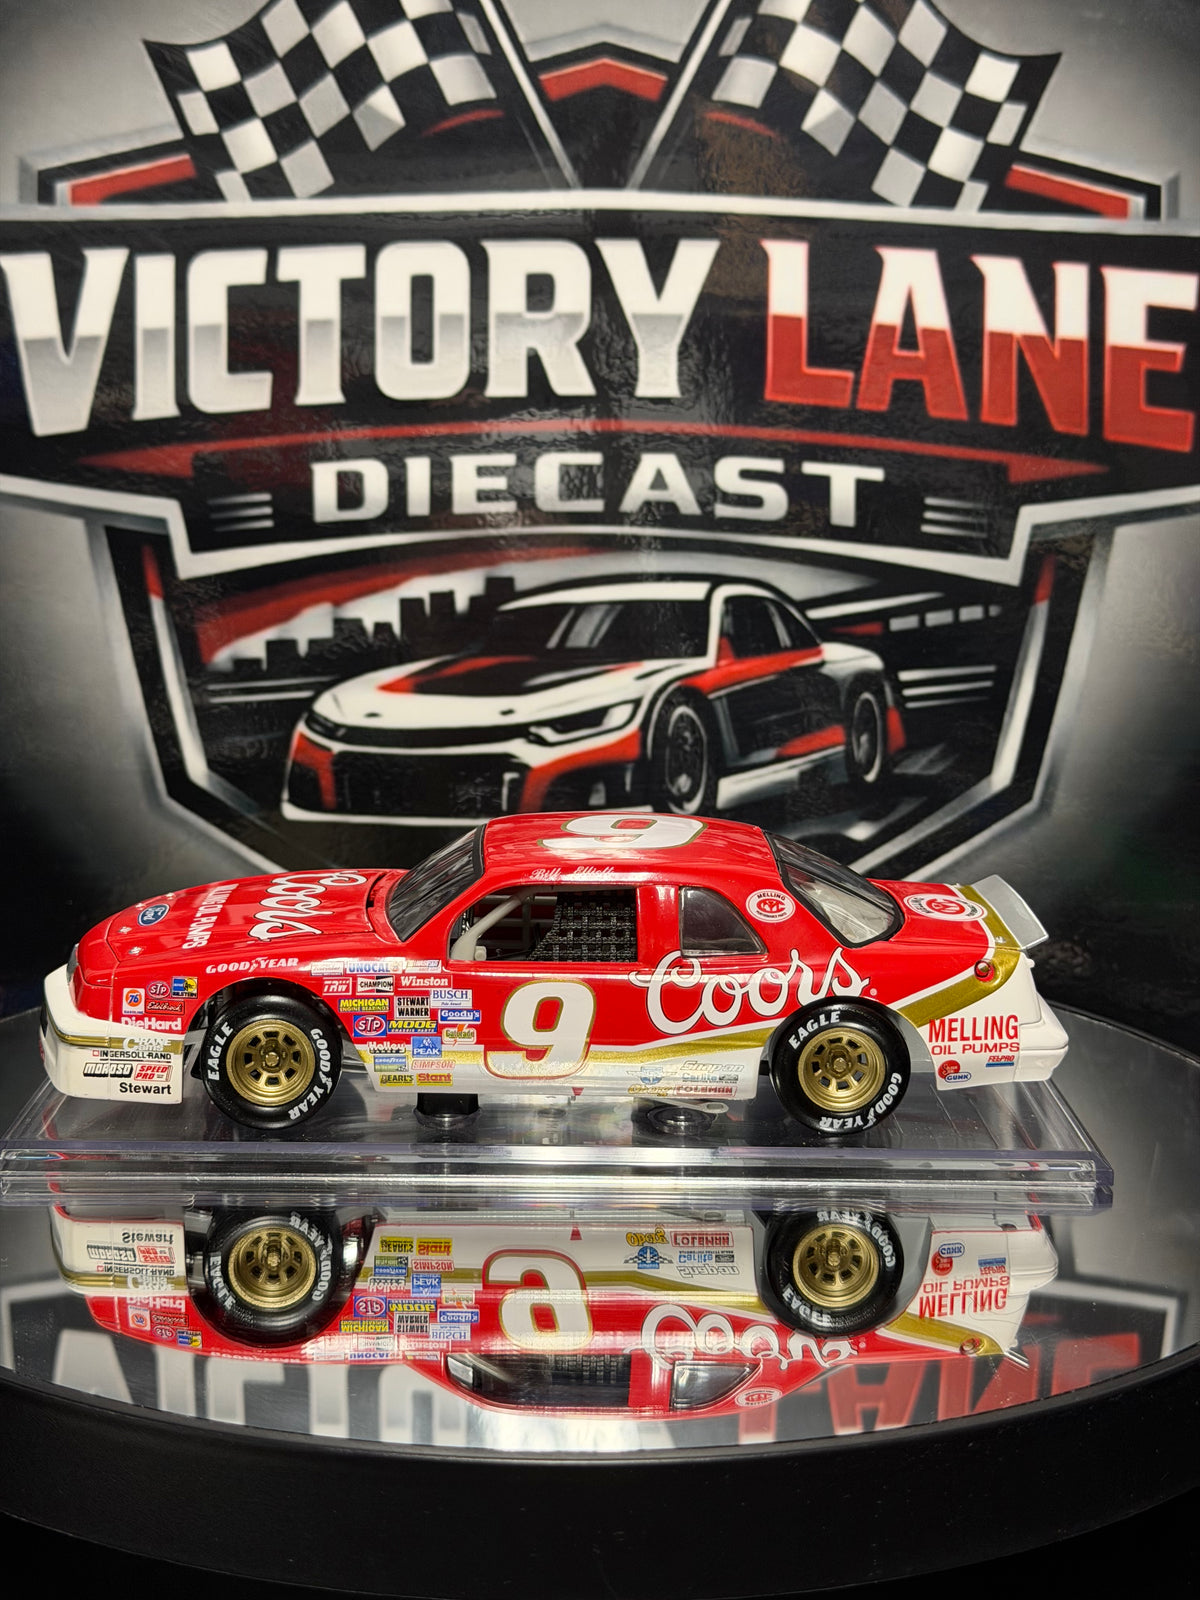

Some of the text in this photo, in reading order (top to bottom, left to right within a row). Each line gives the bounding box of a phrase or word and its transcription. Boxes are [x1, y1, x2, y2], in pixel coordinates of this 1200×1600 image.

[0, 237, 1199, 452] VICTORY LANE
[310, 450, 885, 524] DIECAST
[537, 814, 707, 849] 9
[757, 893, 786, 901] MELLING
[248, 871, 368, 942] Coors
[205, 957, 299, 974] GOODYEAR
[349, 962, 390, 973] UNOCAL
[323, 981, 350, 992] TRW
[401, 976, 449, 987] Winston
[150, 983, 167, 995] STP
[433, 990, 469, 1000] BUSCH
[628, 947, 870, 1035] Coors
[128, 993, 140, 1004] 76
[340, 999, 389, 1007] MICHIGAN
[397, 997, 429, 1006] STEWART
[397, 1007, 429, 1016] WARNER
[441, 1010, 480, 1020] Goody's
[121, 1016, 182, 1030] DieHard
[358, 1017, 381, 1031] STP
[484, 980, 597, 1078] 9
[928, 1015, 1019, 1043] MELLING
[788, 1011, 840, 1050] EAGLE
[207, 1022, 233, 1080] EAGLE
[367, 1041, 406, 1051] Holley
[931, 1042, 1020, 1056] OIL PUMPS
[100, 1050, 172, 1060] INGERSOLL-RAND
[139, 1065, 168, 1073] SPEED
[413, 1061, 453, 1069] SIMPSON
[680, 1061, 744, 1073] Snap-on
[418, 1073, 452, 1081] Stant
[119, 1082, 172, 1094] Stewart
